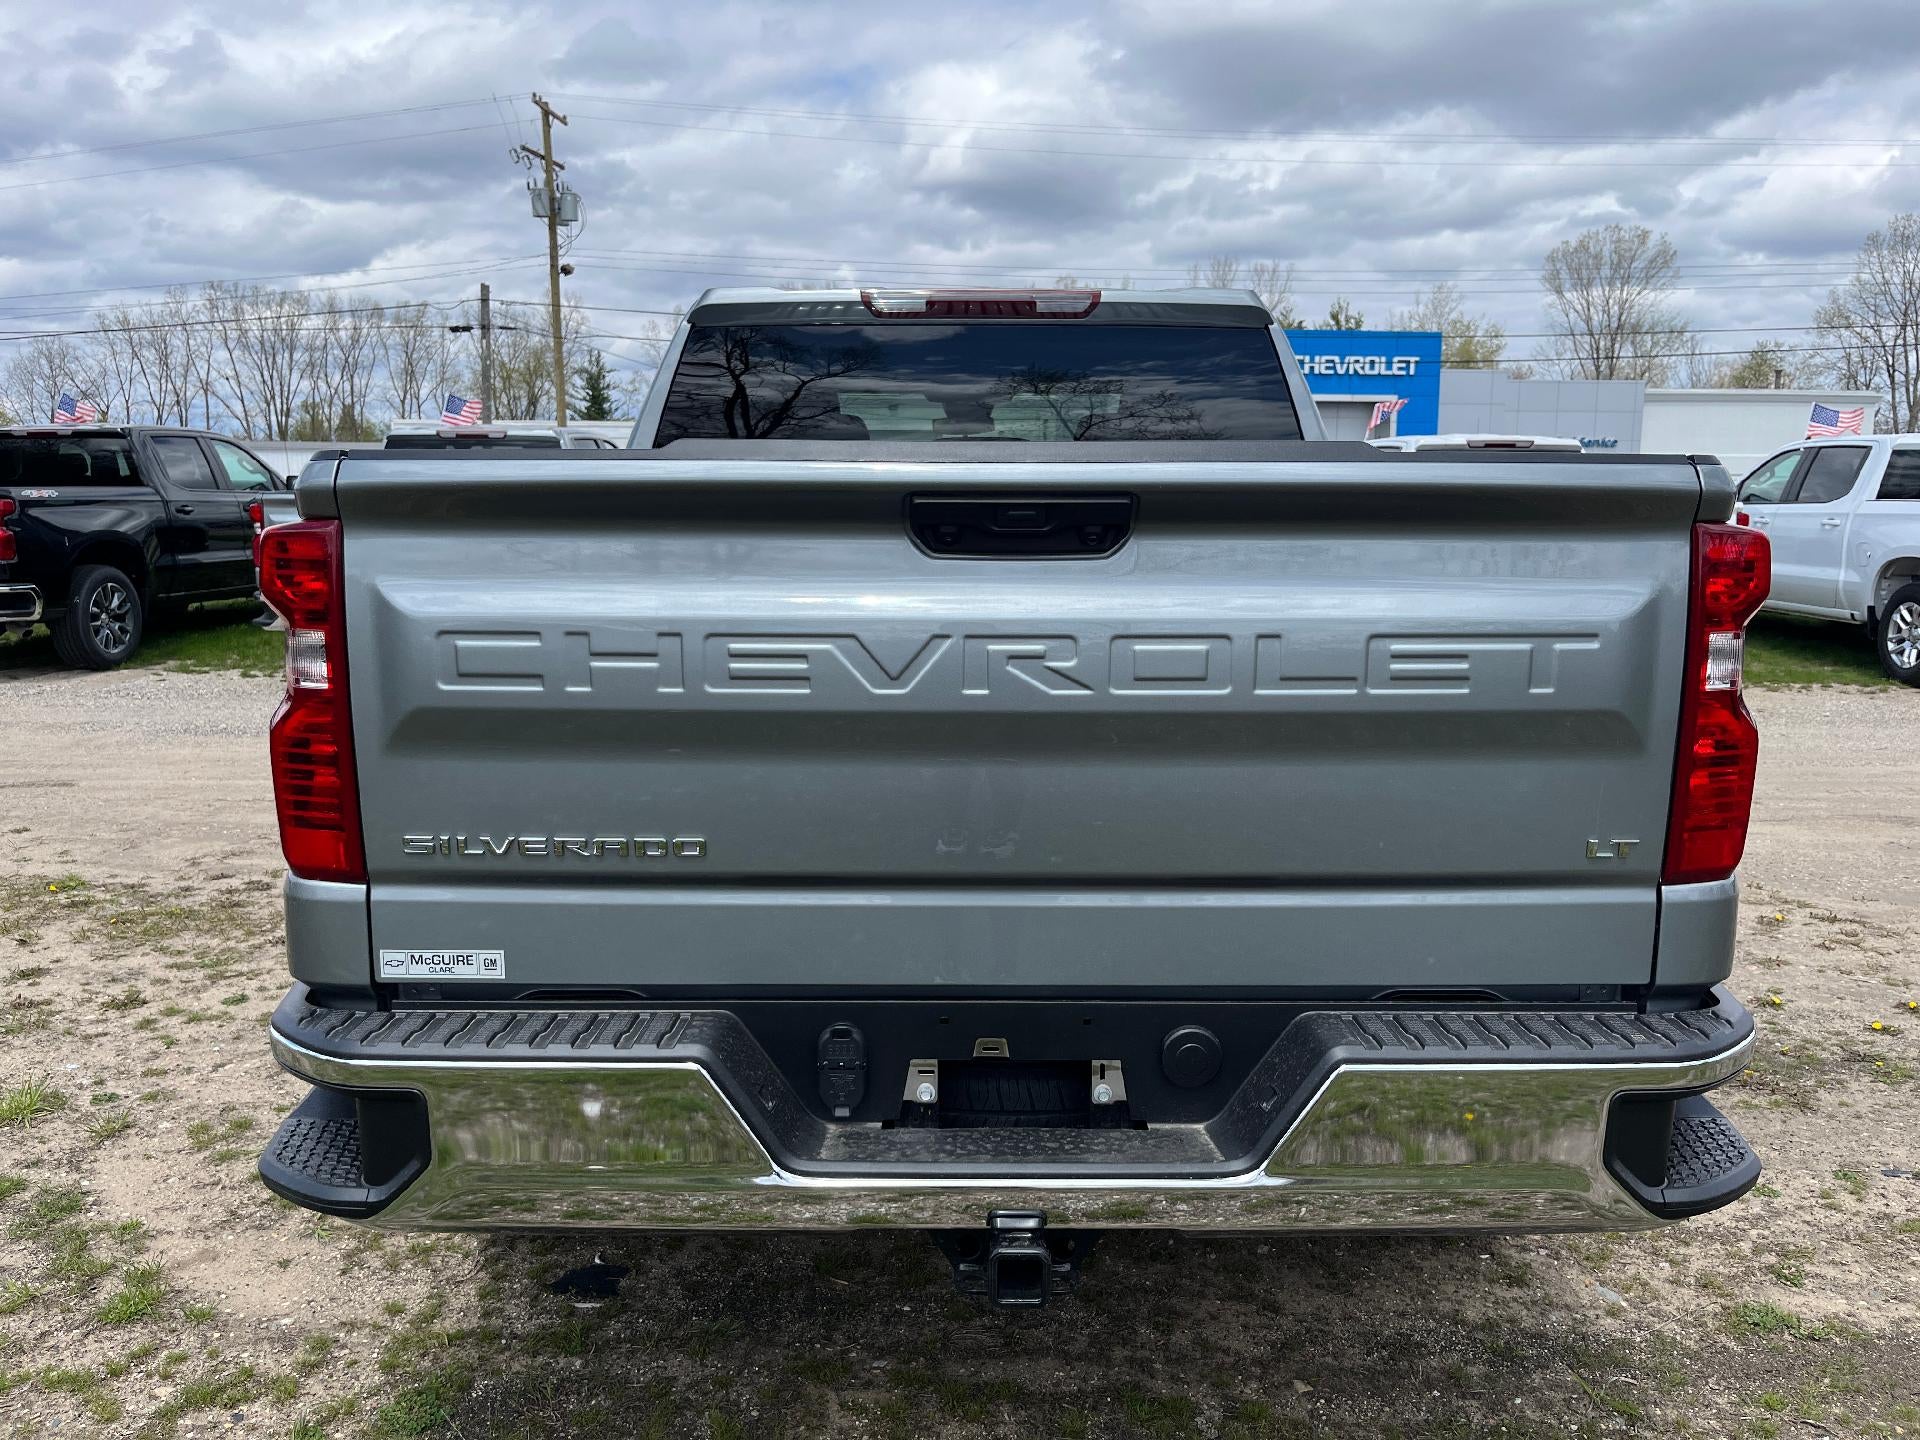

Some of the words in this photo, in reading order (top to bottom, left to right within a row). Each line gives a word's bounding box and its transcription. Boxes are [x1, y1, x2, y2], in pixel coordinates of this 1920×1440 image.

[435, 631, 1601, 695] CHEVROLET
[402, 835, 708, 857] SILVERADO
[1586, 839, 1640, 857] LT
[410, 954, 474, 966] McGUIRE
[483, 957, 497, 968] GM
